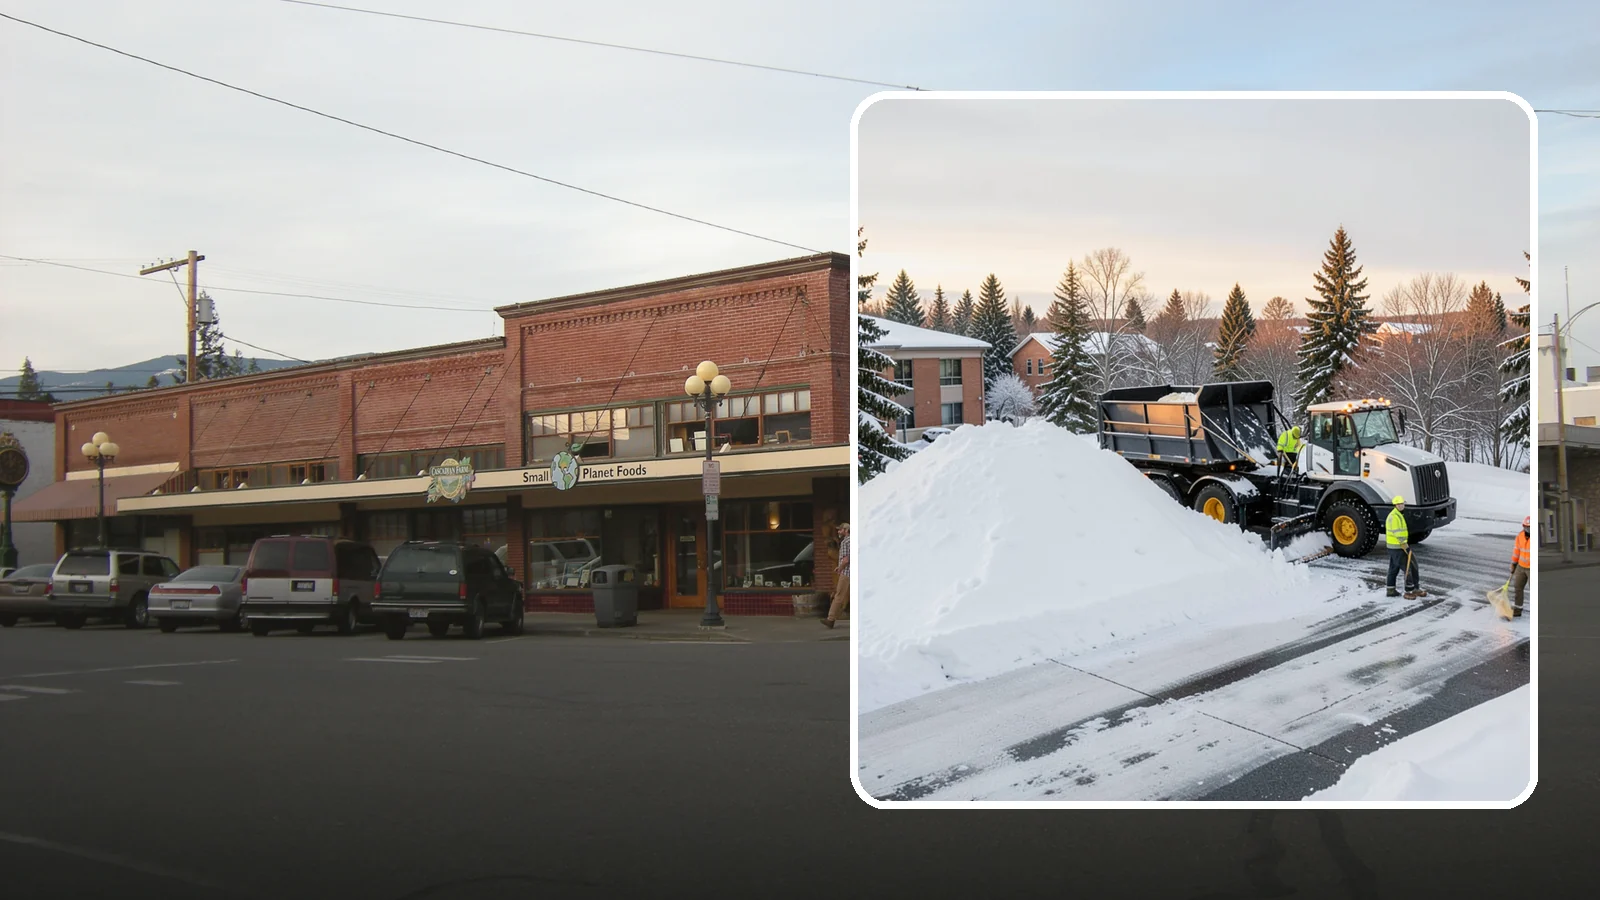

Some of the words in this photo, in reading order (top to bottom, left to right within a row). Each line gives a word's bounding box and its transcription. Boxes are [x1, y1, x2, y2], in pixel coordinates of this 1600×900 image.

[431, 466, 456, 475] CASCADIAN
[456, 465, 469, 474] FARM
[523, 470, 548, 482] Small
[582, 468, 614, 479] Planet
[617, 464, 646, 476] Foods
